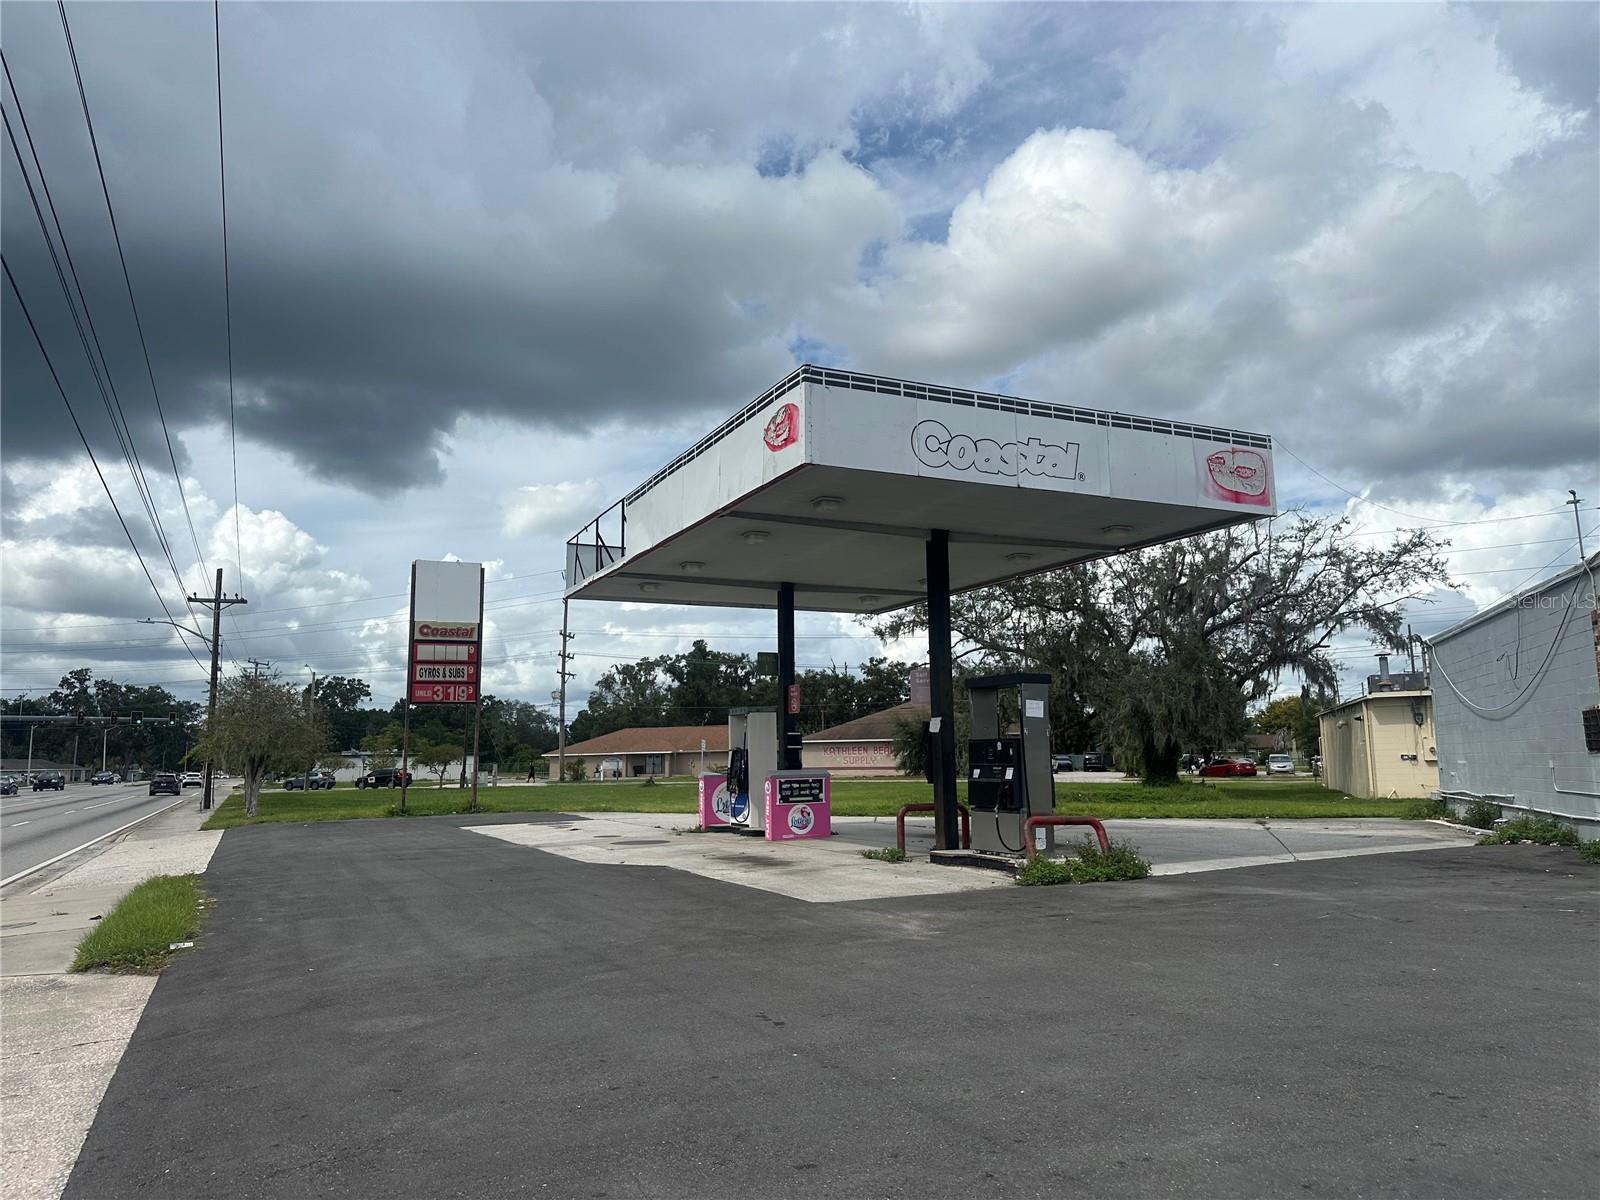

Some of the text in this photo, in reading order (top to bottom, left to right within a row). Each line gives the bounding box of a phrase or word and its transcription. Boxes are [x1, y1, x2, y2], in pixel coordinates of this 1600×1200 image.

[419, 624, 475, 638] Coastal
[469, 646, 474, 654] 9
[419, 667, 466, 679] GYROS & SUBS
[468, 666, 474, 674] 9
[823, 746, 869, 756] KATHLEEN
[843, 756, 876, 765] SUPPLY
